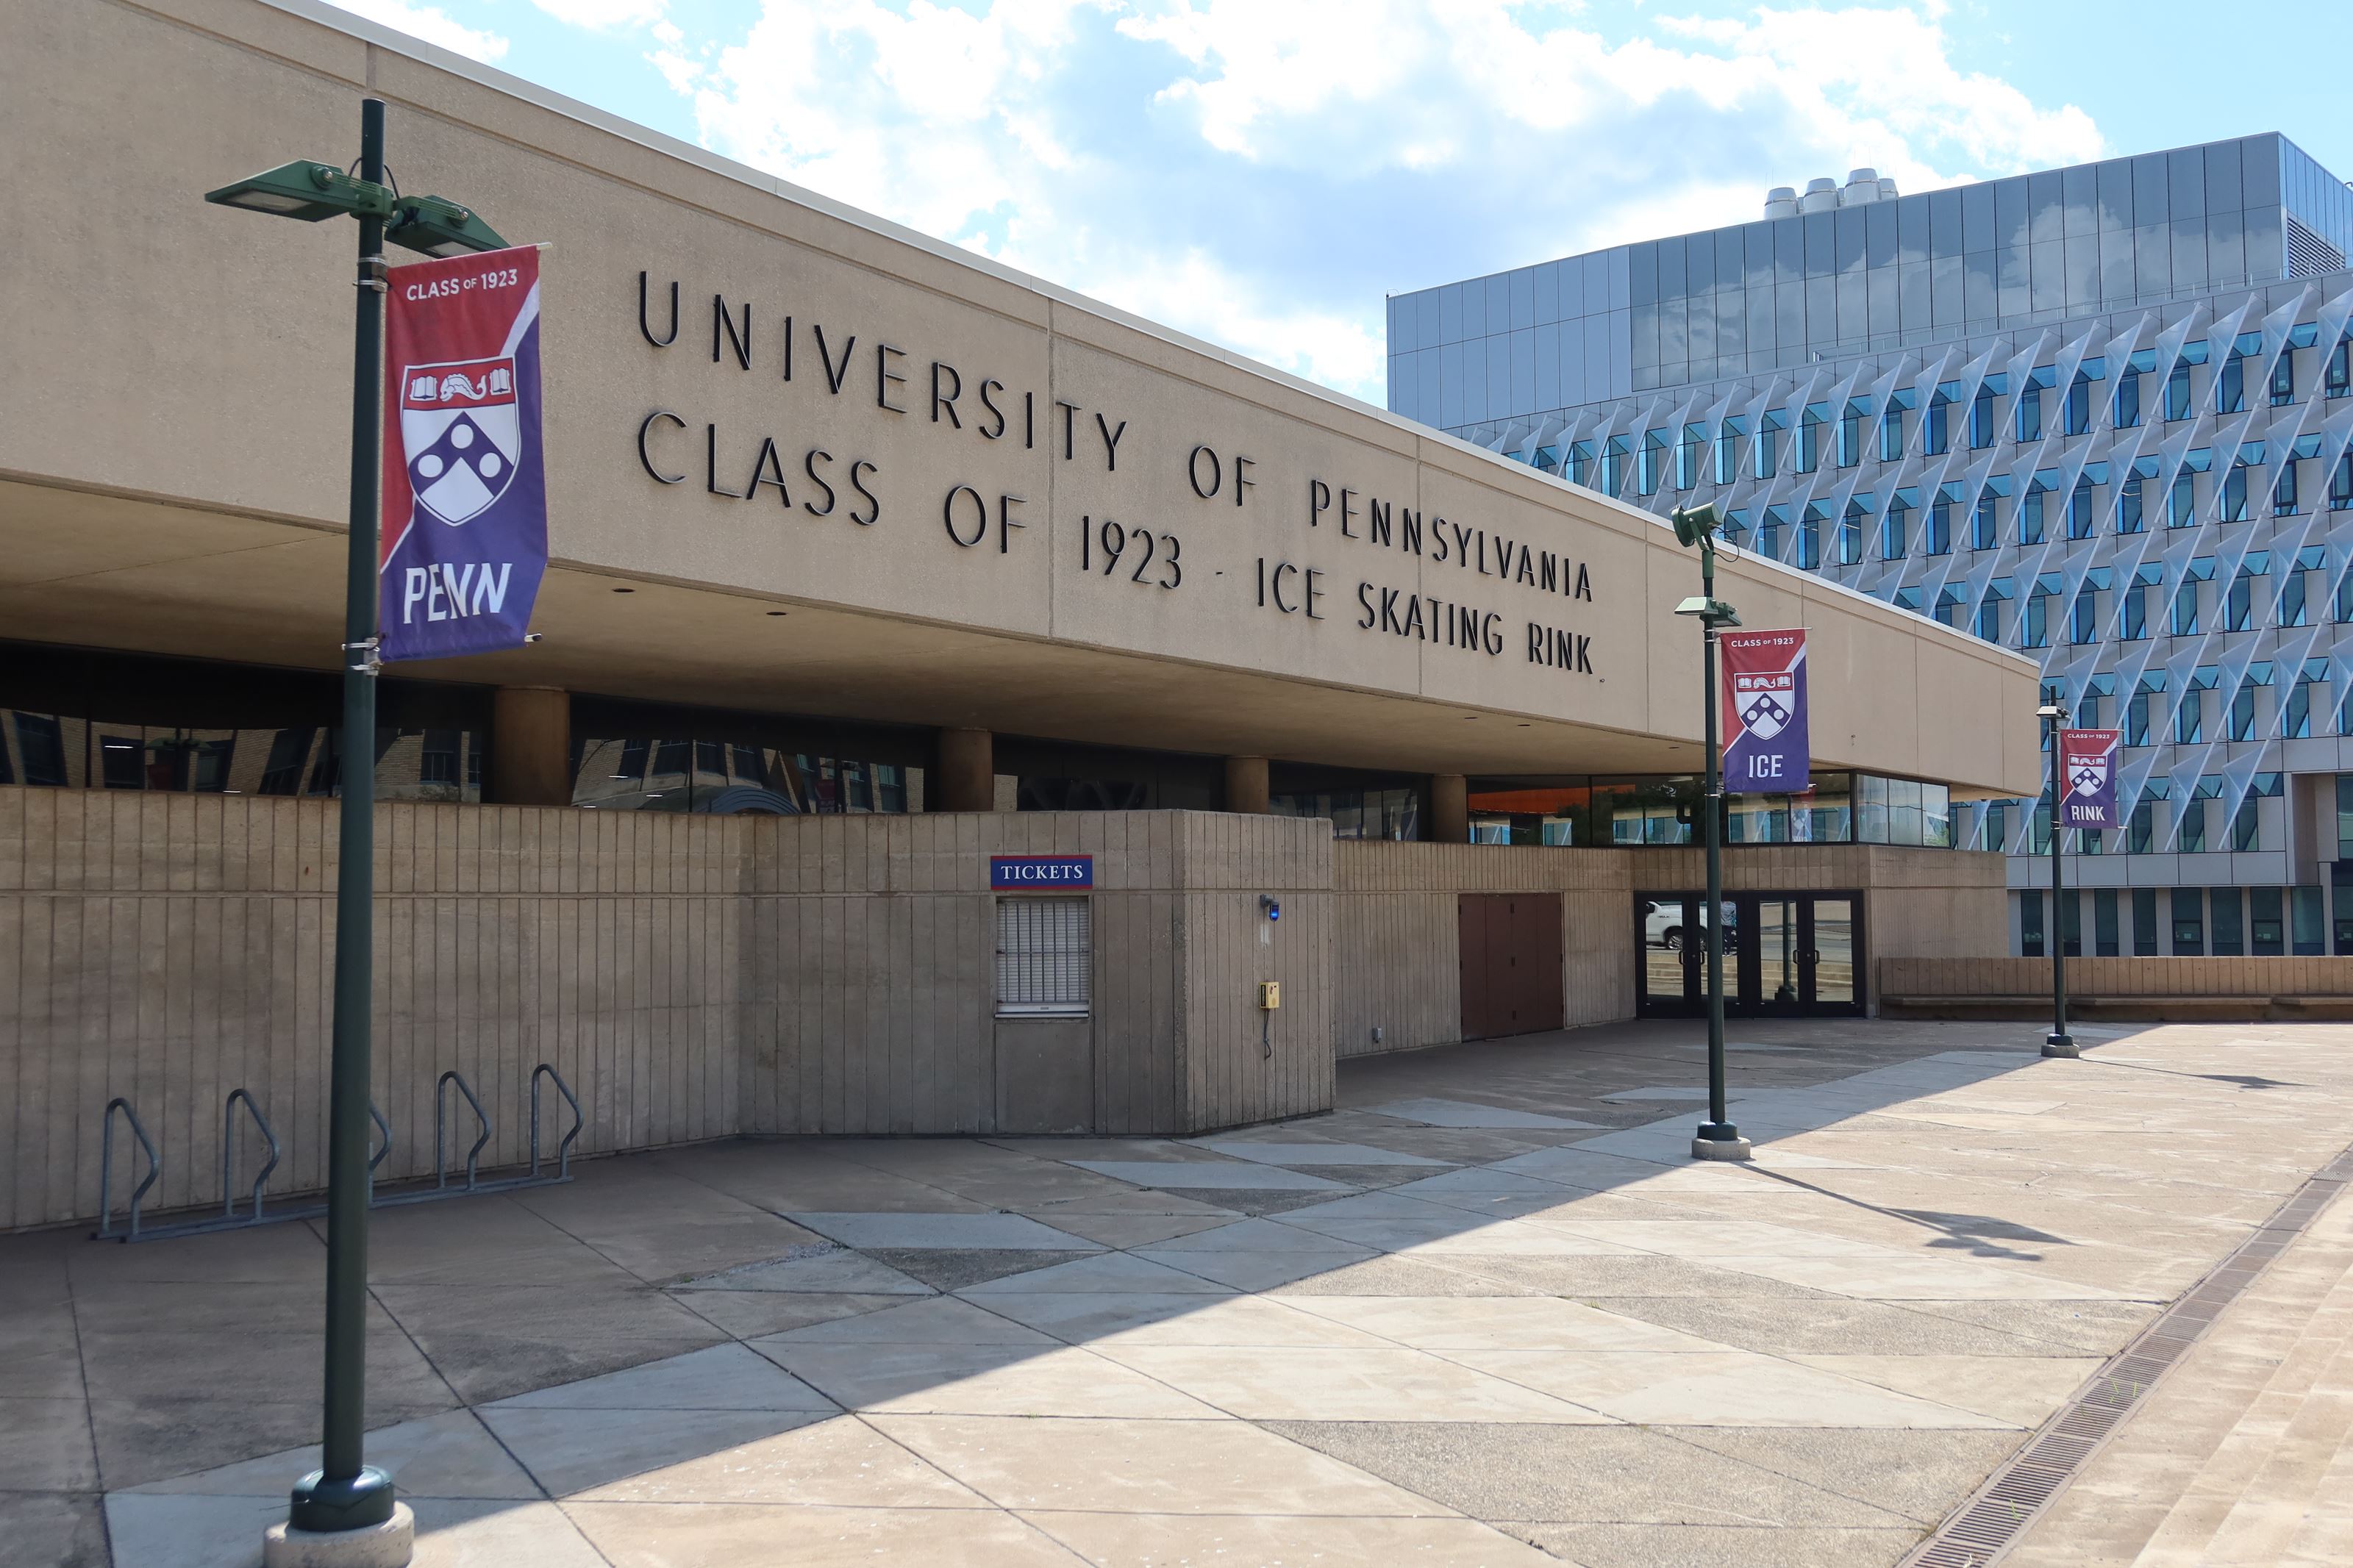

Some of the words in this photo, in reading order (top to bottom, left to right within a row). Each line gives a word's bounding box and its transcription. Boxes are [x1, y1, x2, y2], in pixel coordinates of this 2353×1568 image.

[407, 278, 460, 301] CLASS
[463, 278, 477, 290] OF
[481, 268, 518, 290] 1923
[638, 270, 1127, 471] UNIVERSITY
[1189, 445, 1257, 507] OF
[1310, 479, 1593, 603] PENNSYLVANIA
[638, 411, 881, 526] CLASS
[944, 484, 1027, 554] OF
[1082, 515, 1182, 590] 1923
[1258, 556, 1326, 620] ICE
[1358, 581, 1503, 656] SKATING
[1528, 622, 1593, 676] RINK
[404, 562, 513, 624] PENN
[1731, 640, 1761, 648] CLASS
[1773, 637, 1794, 645] 1923
[1748, 754, 1783, 778] ICE
[2071, 805, 2106, 821] RINK
[1000, 865, 1084, 880] TICKETS
